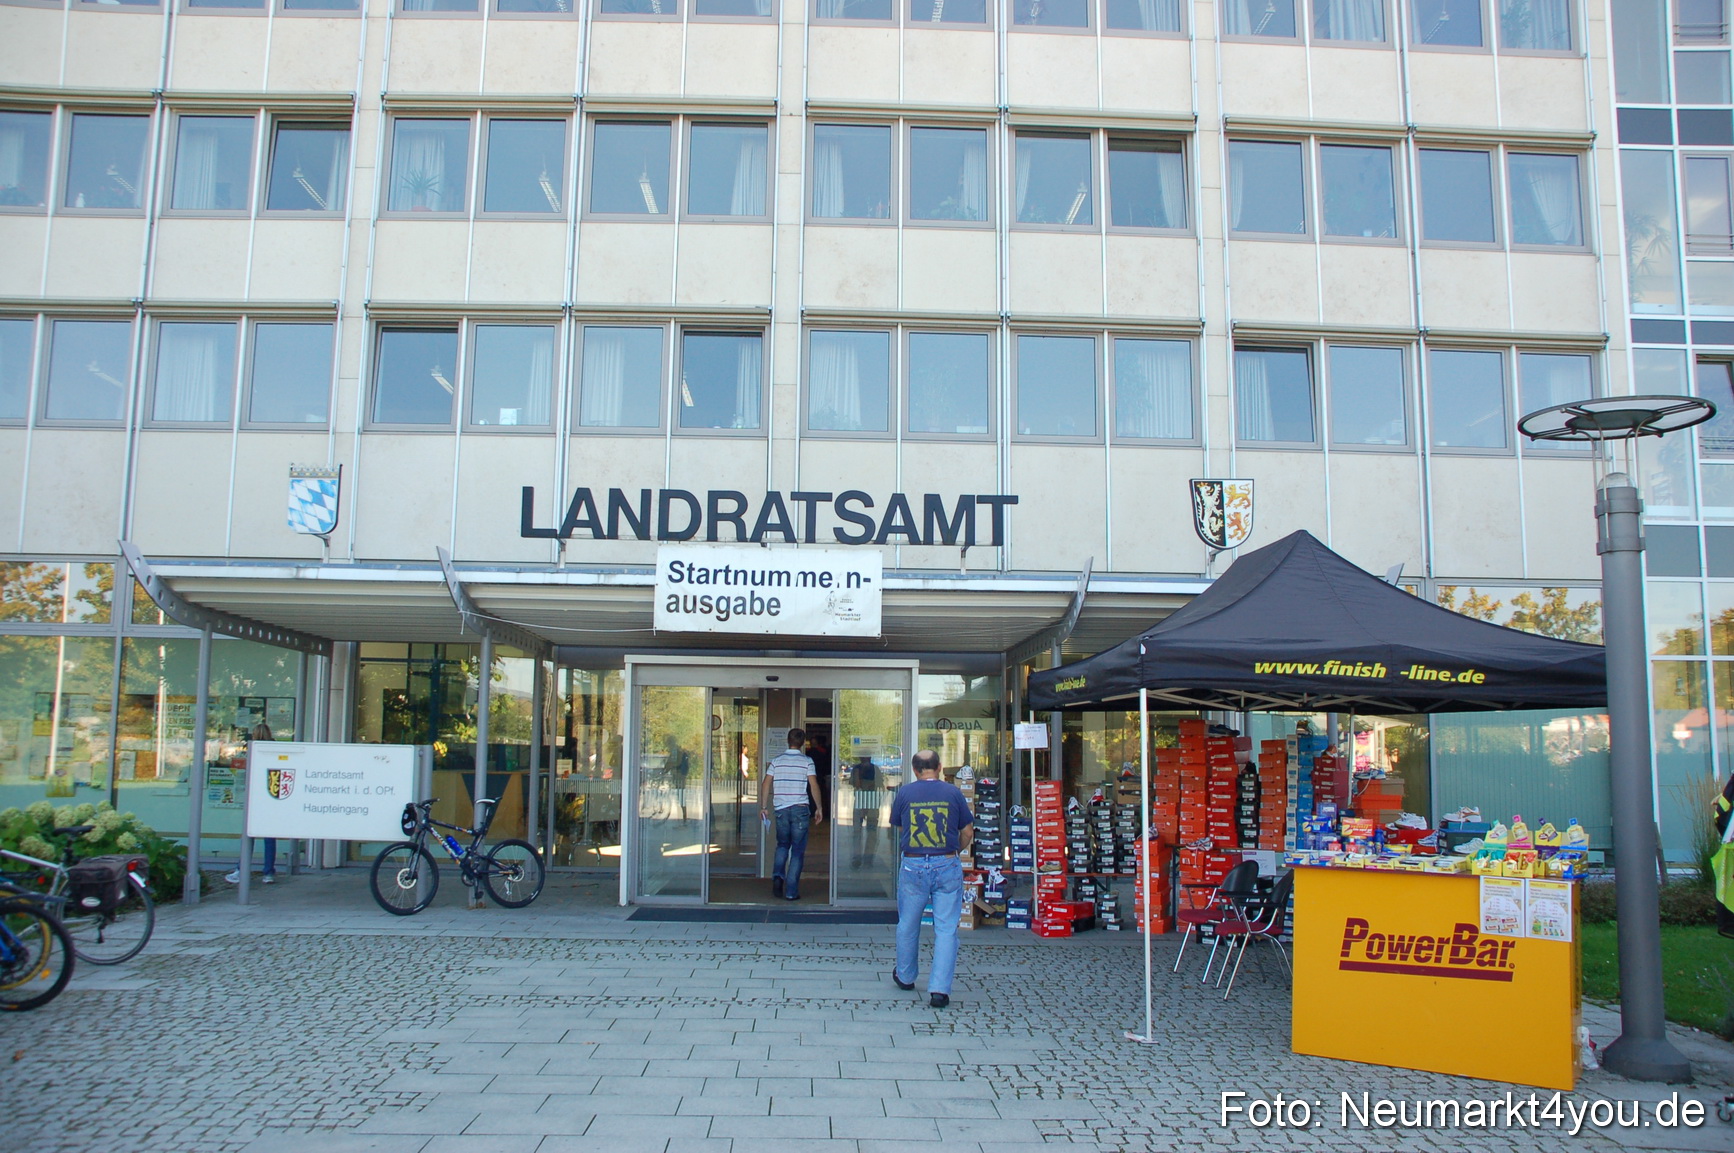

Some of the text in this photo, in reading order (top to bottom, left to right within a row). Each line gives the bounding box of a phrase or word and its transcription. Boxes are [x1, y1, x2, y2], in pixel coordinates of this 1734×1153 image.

[521, 486, 1019, 546] LANDRATSAMT
[667, 559, 872, 588] Startnummen-
[666, 590, 781, 622] ausgabe
[1254, 660, 1486, 684] www.finish -line.de
[305, 769, 364, 780] Landratsamt
[304, 784, 350, 794] Neumarkt
[354, 785, 360, 795] i.
[363, 786, 372, 795] d.
[303, 803, 369, 816] Haupteingang
